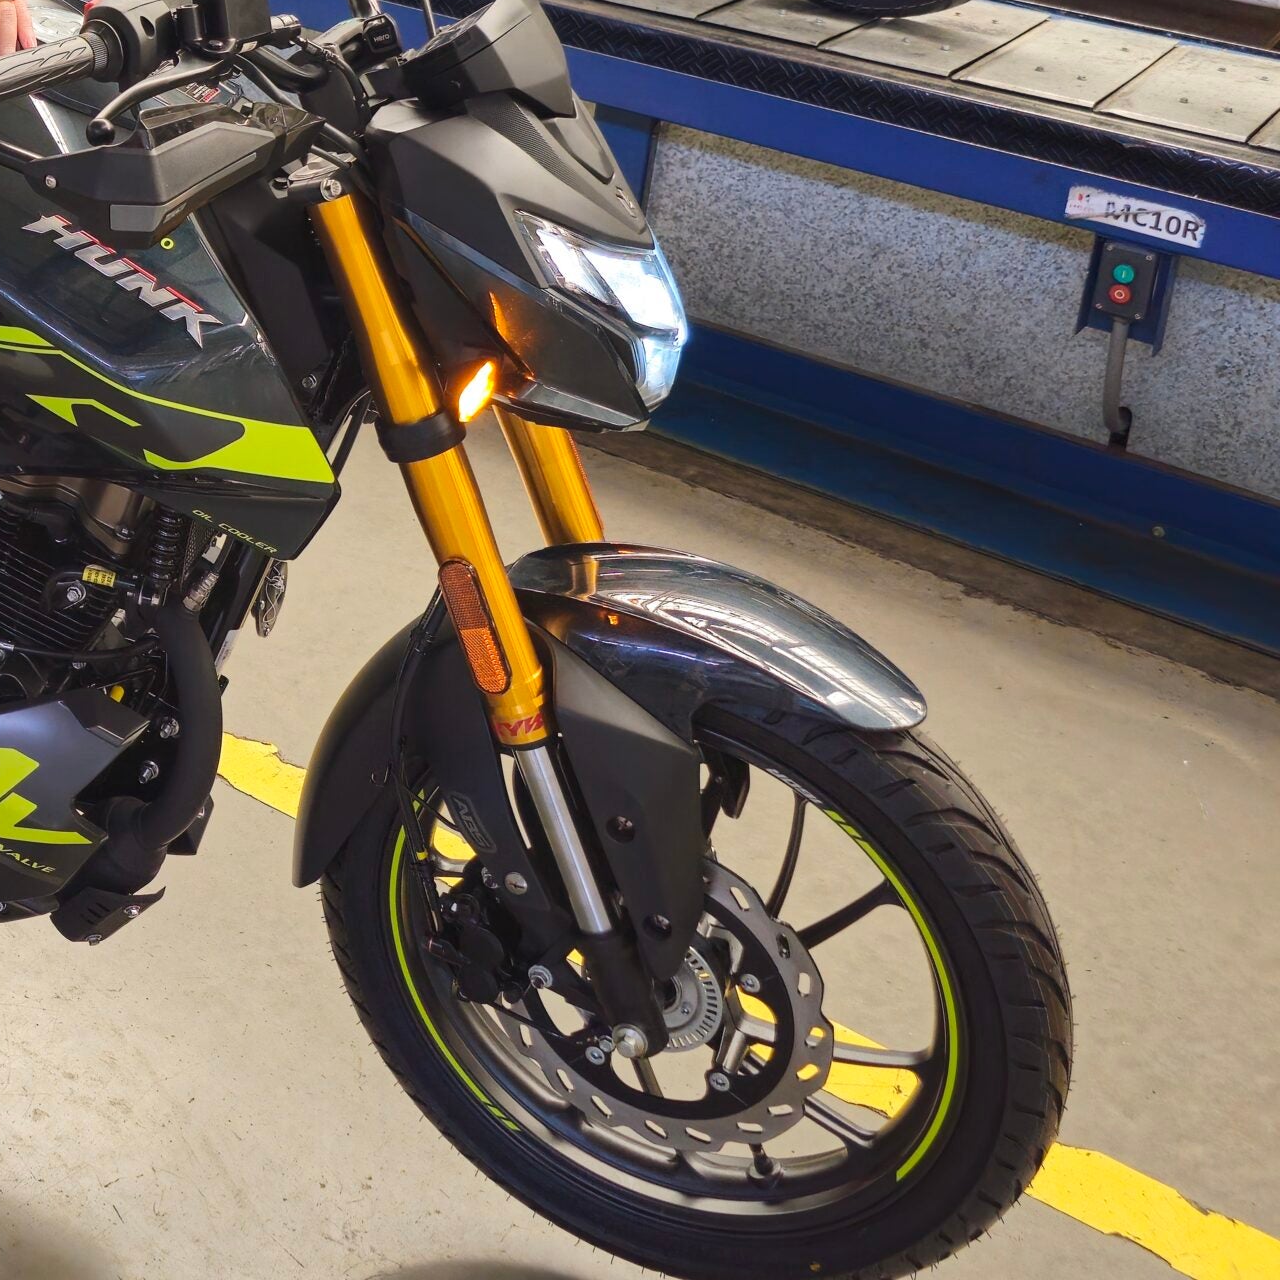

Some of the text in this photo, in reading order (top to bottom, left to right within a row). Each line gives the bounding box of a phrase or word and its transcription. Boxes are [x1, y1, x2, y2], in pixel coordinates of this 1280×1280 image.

[21, 214, 224, 349] HUNK
[192, 509, 278, 554] OIL COOLER
